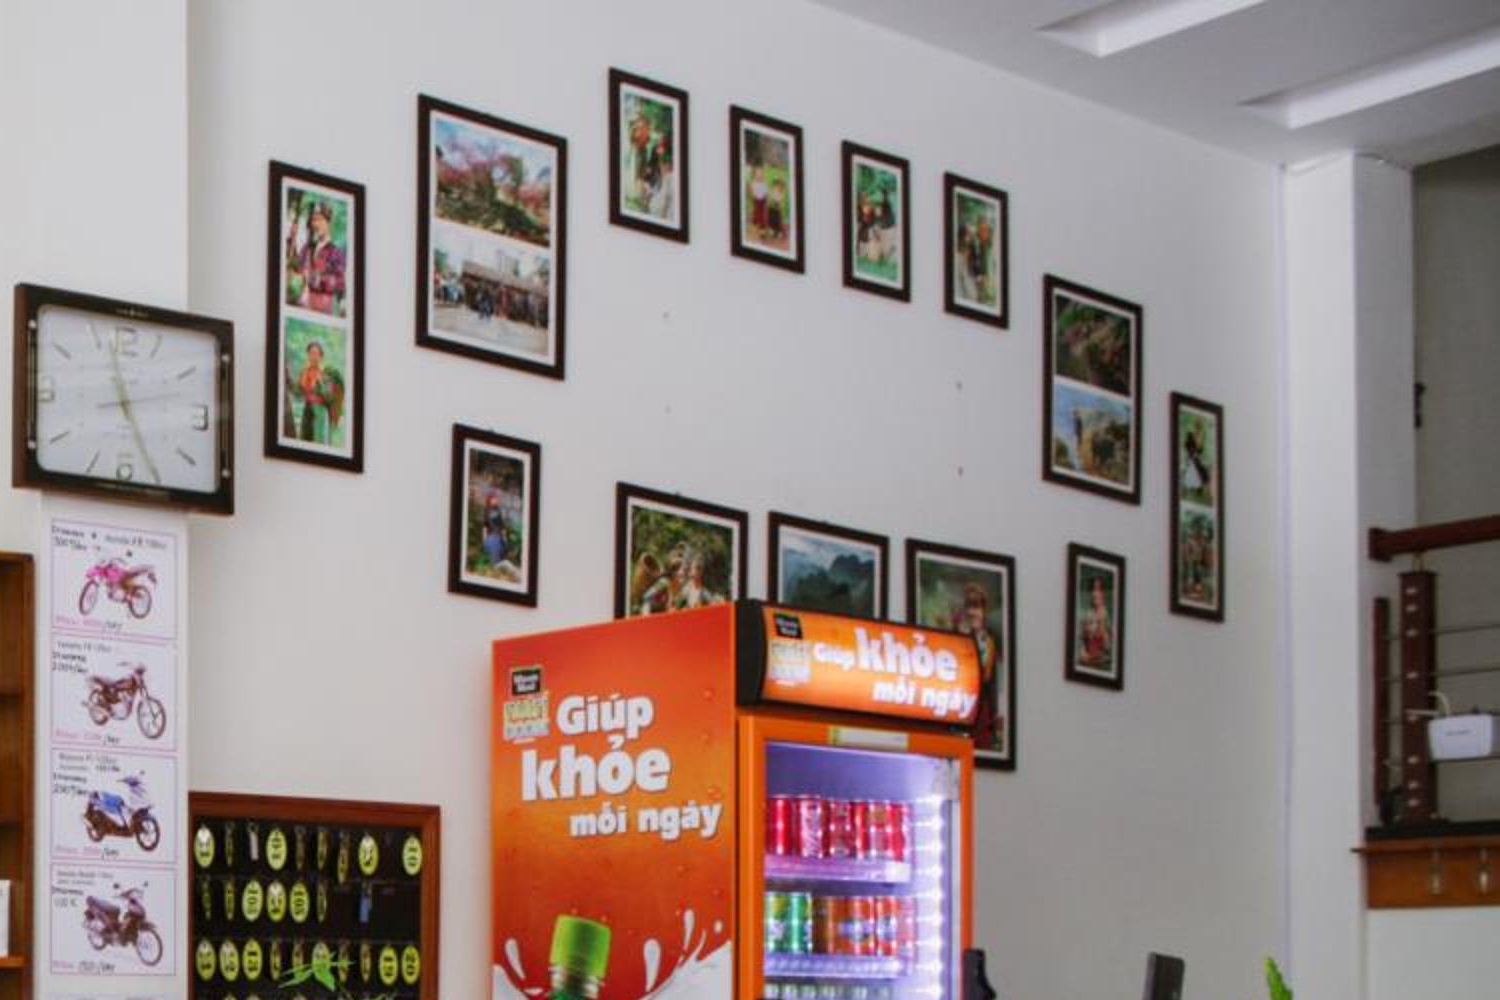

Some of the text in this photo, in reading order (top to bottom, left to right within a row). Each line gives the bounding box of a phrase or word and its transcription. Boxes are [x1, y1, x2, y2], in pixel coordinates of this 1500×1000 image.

[853, 627, 959, 682] khỏe
[556, 694, 654, 739] Giúp
[521, 735, 672, 802] khỏe
